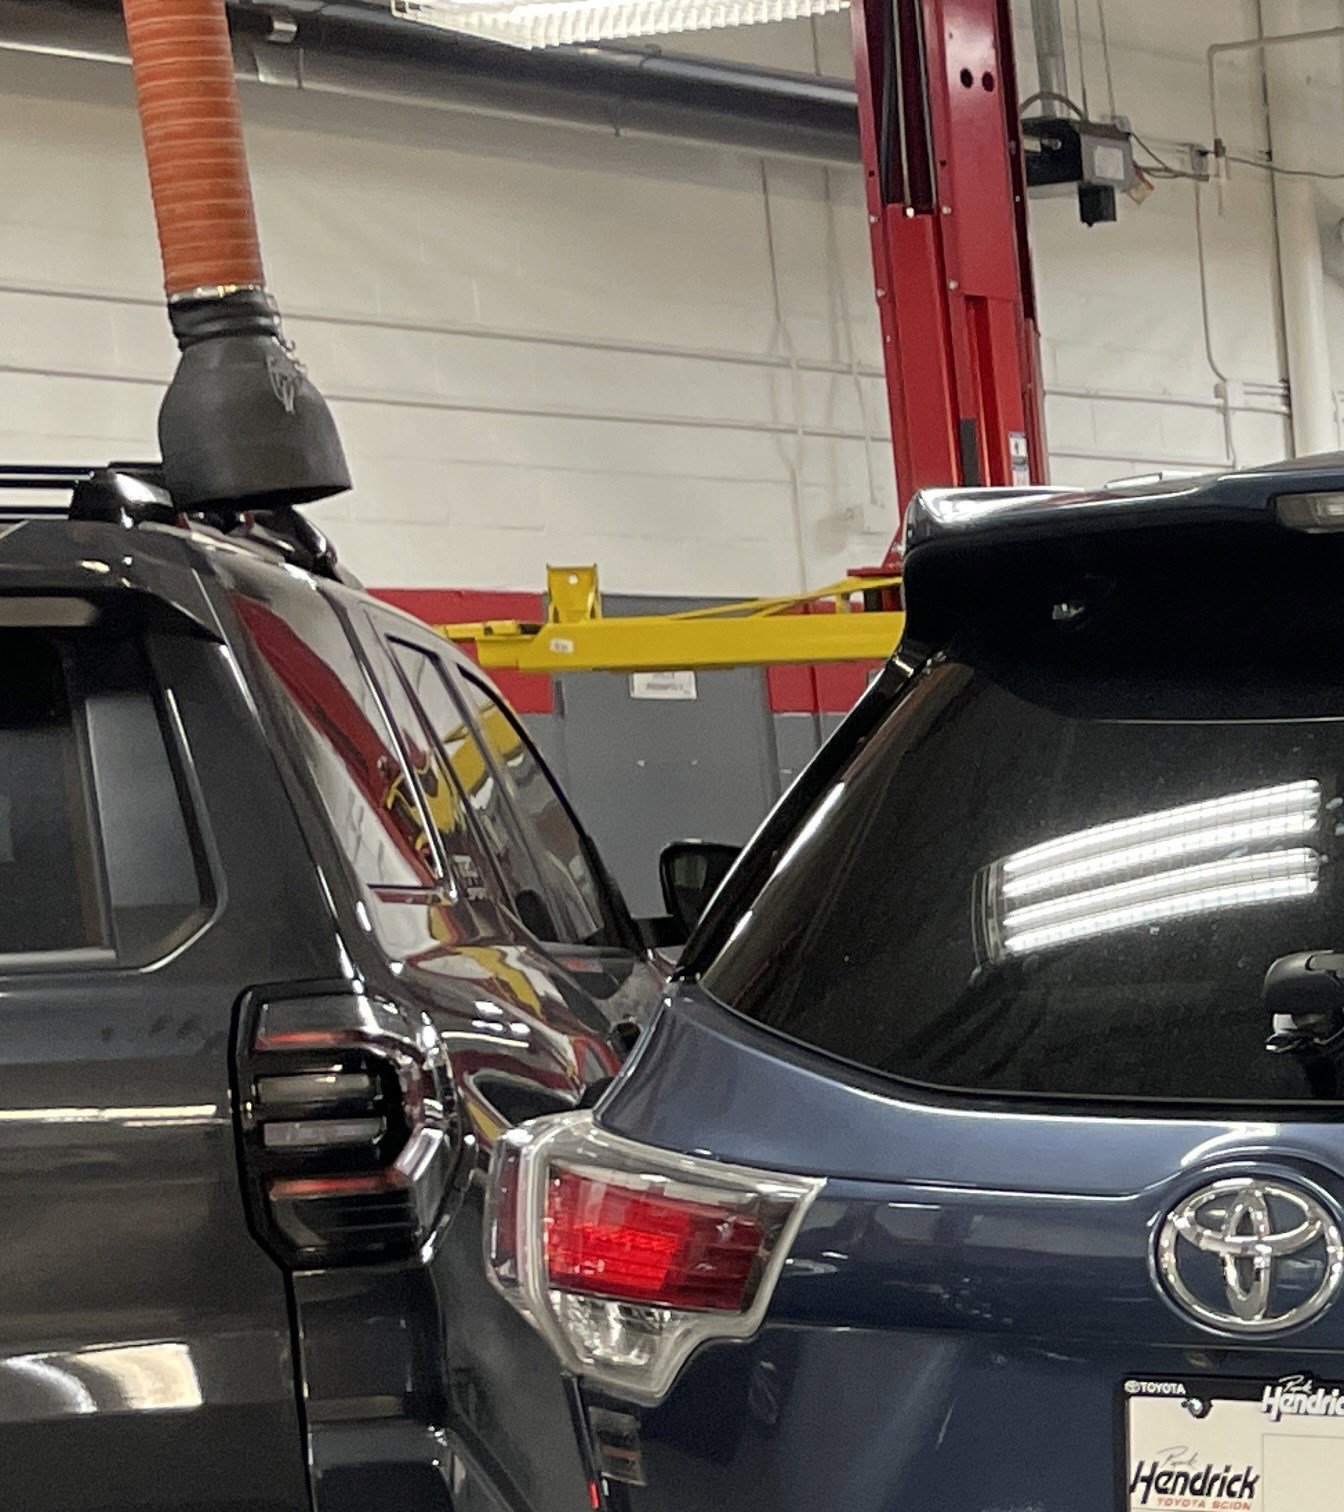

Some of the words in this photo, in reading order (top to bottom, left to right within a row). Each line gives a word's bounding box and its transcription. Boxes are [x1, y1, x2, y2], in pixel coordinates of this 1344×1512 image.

[1140, 1381, 1187, 1395] TOYOTA
[1130, 1460, 1260, 1505] Hendrick
[1157, 1497, 1206, 1509] TOYOTA
[1212, 1500, 1252, 1511] SCION
